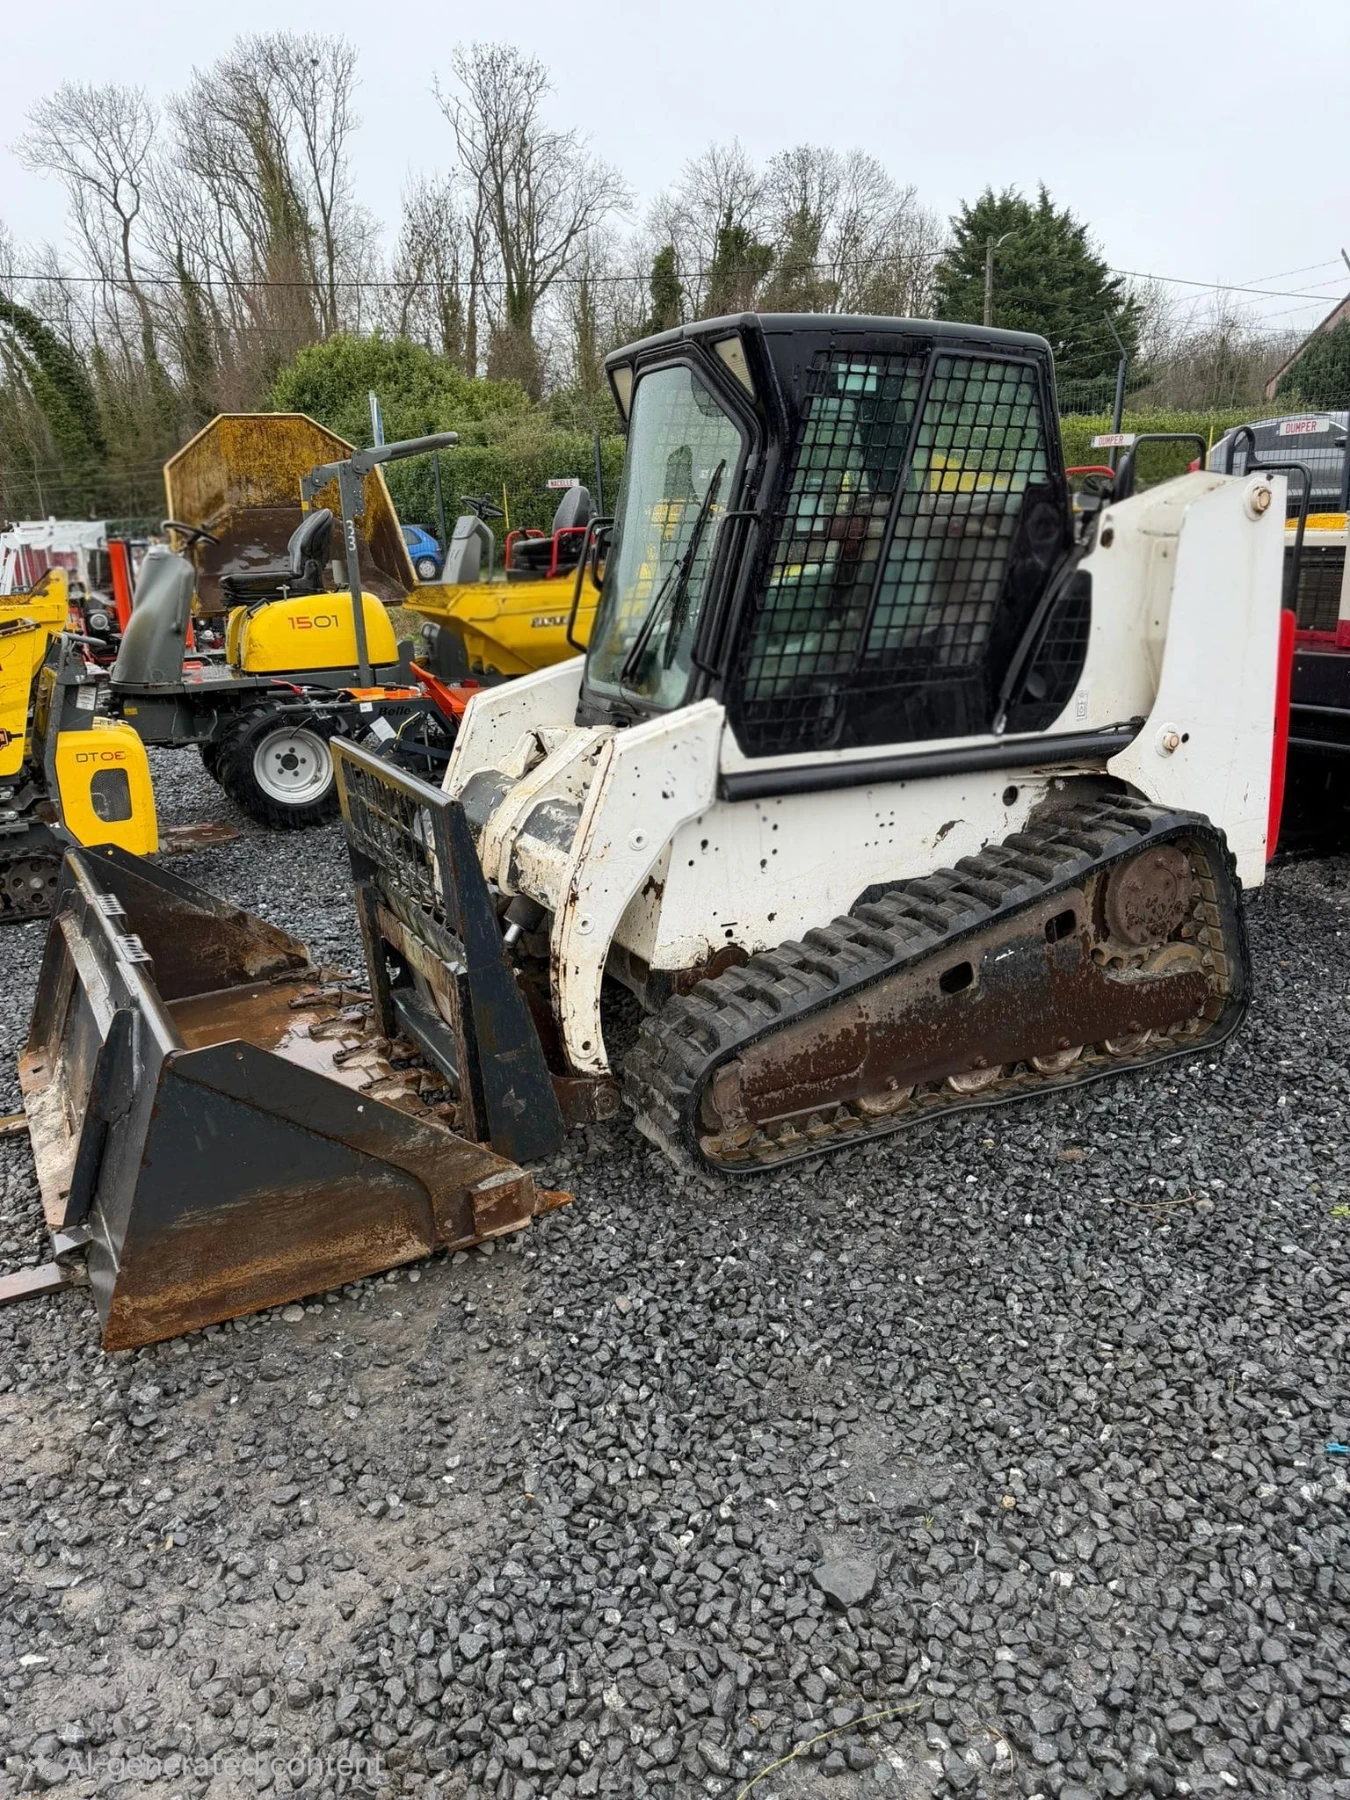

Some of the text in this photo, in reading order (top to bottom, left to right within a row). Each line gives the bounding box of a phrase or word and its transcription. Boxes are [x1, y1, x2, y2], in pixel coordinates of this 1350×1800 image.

[1286, 421, 1317, 434] DUMPER
[1098, 435, 1124, 446] DUMPER
[287, 614, 339, 630] 1501
[378, 706, 412, 716] Belle
